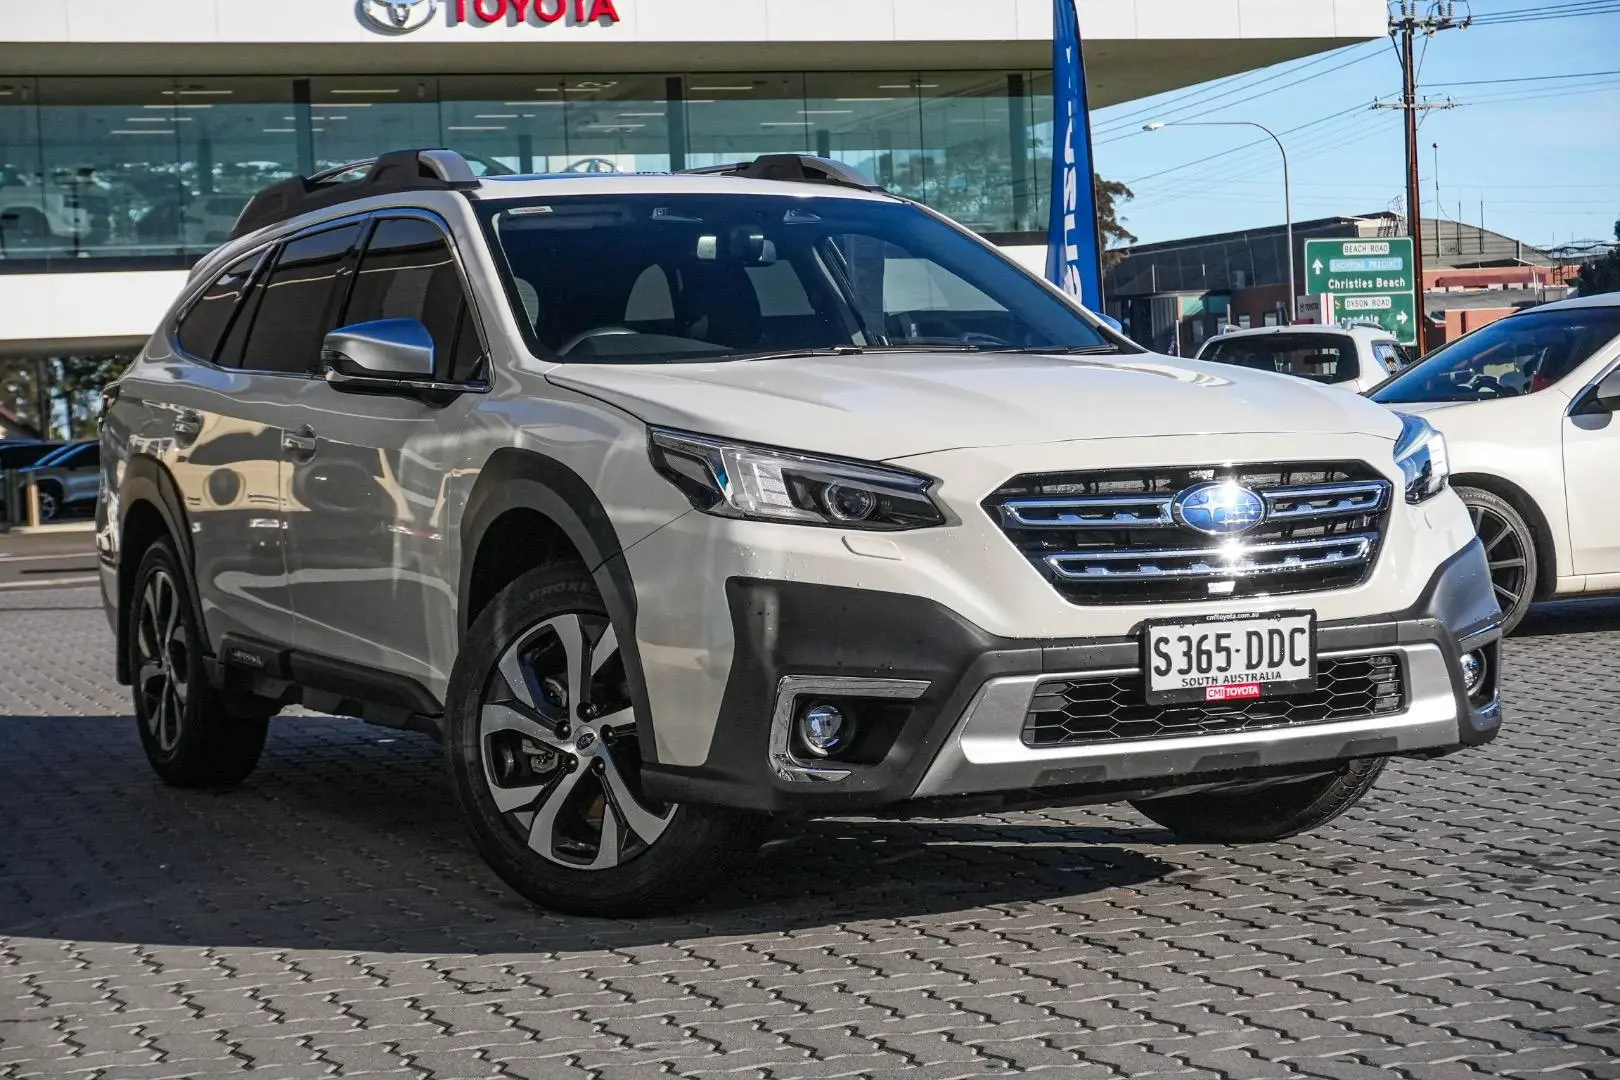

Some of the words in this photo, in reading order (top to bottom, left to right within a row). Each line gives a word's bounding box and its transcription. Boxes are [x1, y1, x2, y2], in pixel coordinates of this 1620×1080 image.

[452, 0, 620, 22] TOYOTA
[1344, 244, 1367, 253] BEACH
[1370, 243, 1388, 252] ROAD
[1328, 278, 1373, 289] Christies
[1376, 277, 1405, 288] Beach
[1346, 299, 1369, 308] DYSON
[1372, 298, 1390, 307] ROAD
[1182, 676, 1218, 687] SOUTH
[1223, 671, 1282, 684] AUSTRALIA
[1208, 688, 1224, 698] CMI
[1226, 686, 1259, 696] TOYOTA
